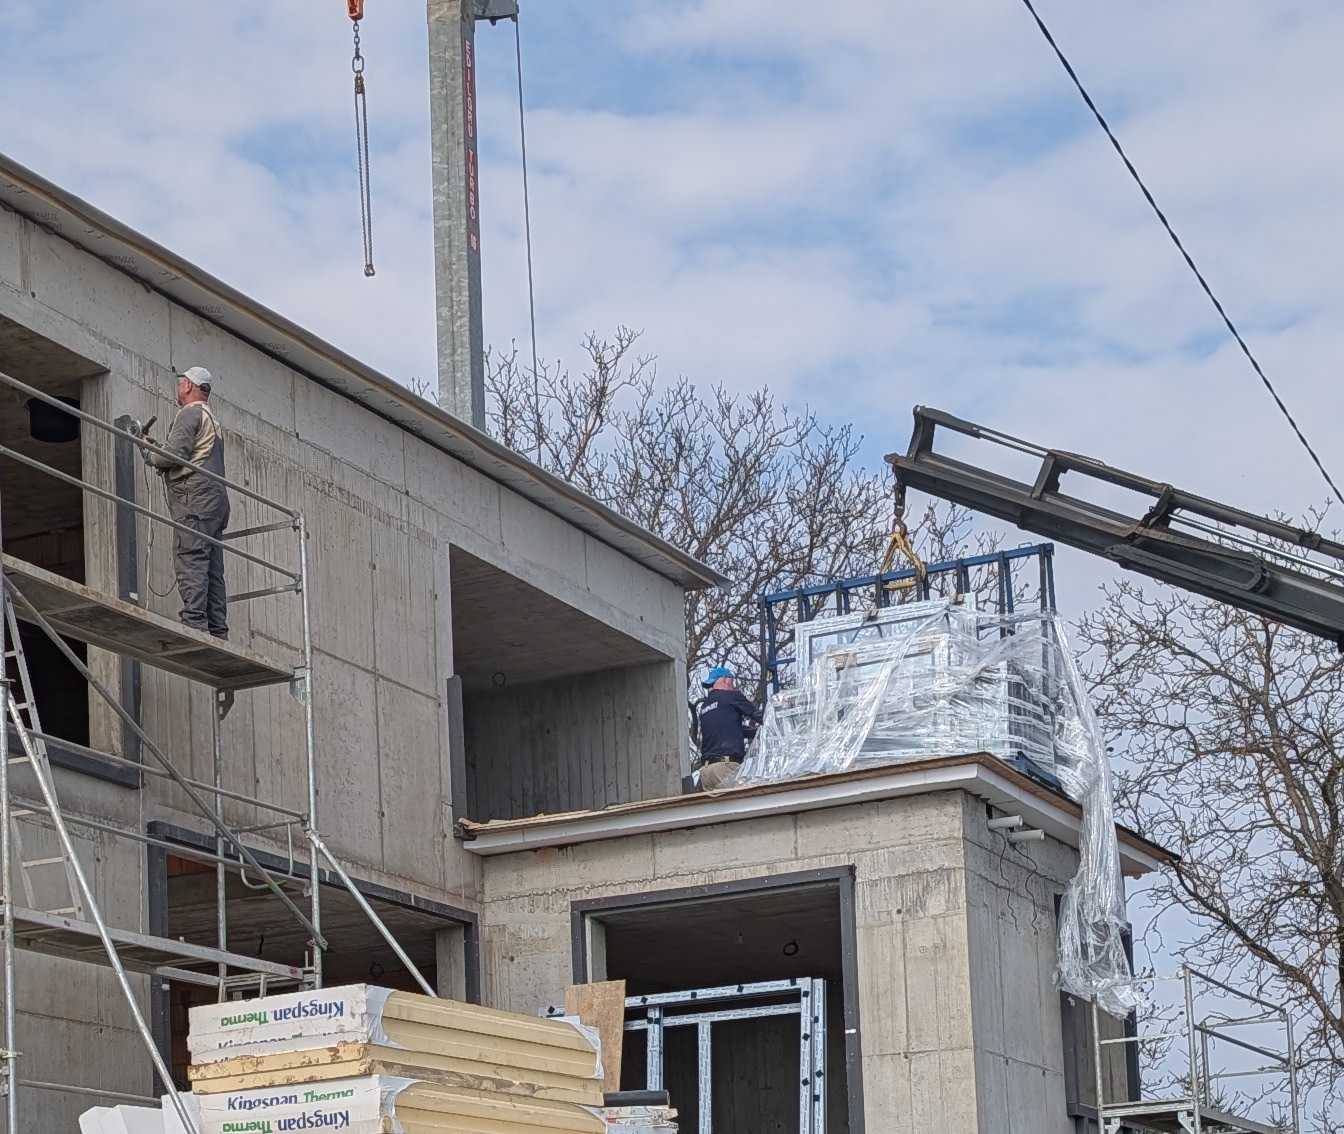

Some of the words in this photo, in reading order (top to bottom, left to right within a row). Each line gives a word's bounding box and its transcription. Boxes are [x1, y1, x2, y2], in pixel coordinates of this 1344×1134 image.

[273, 999, 344, 1020] Kingspan
[220, 1011, 269, 1027] Therma
[222, 1120, 273, 1134] Therma
[277, 1109, 350, 1131] Kingspan
